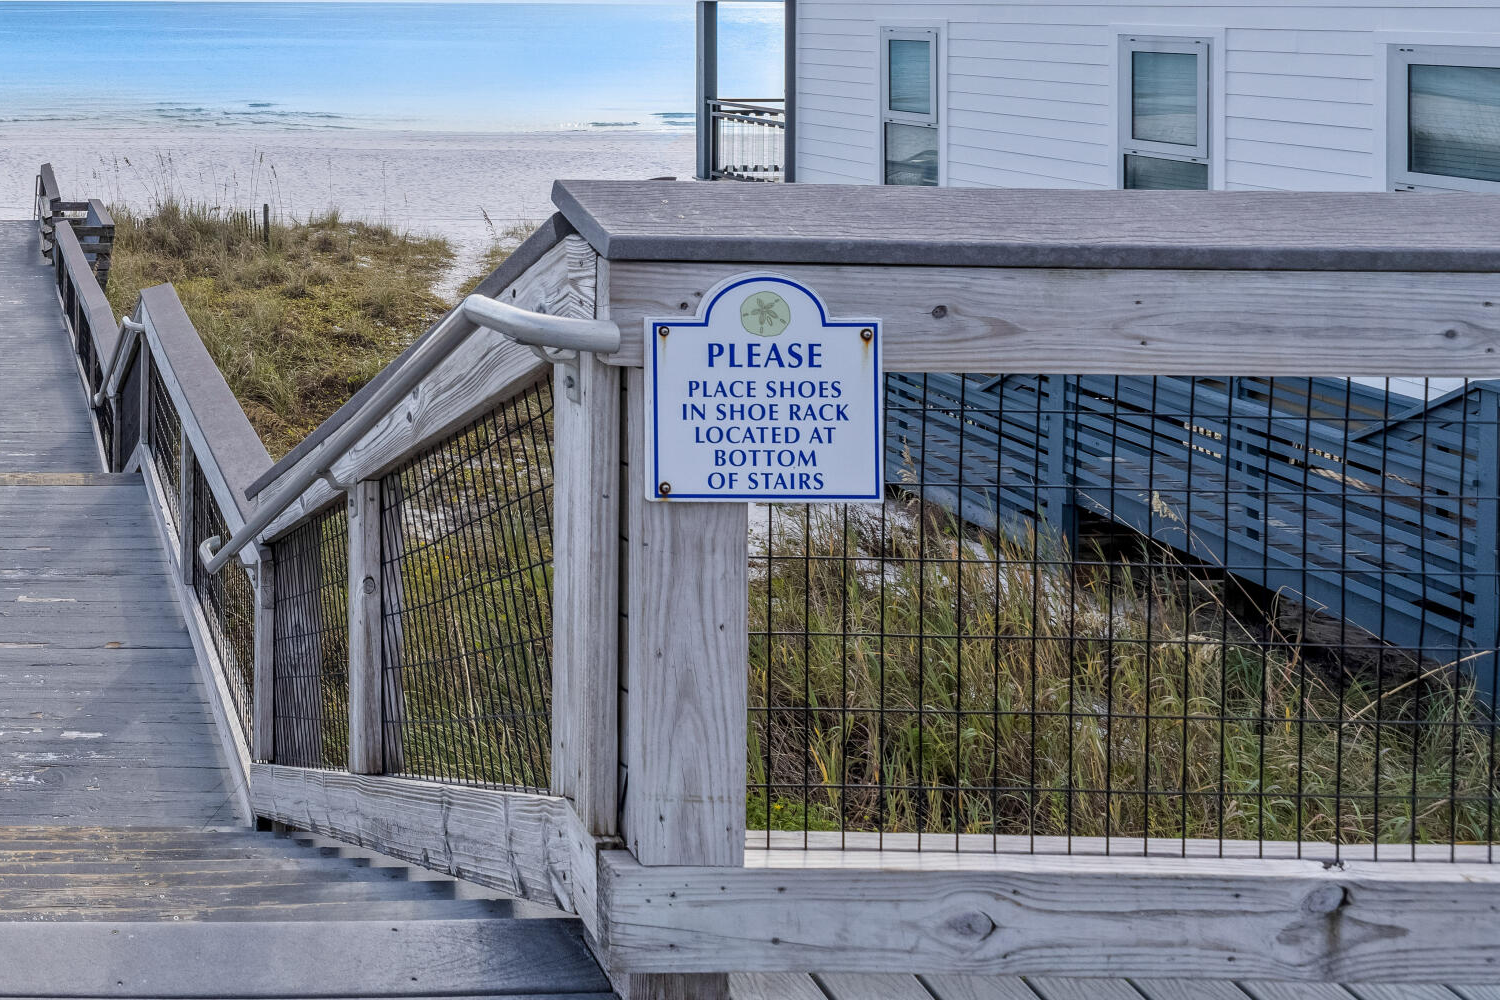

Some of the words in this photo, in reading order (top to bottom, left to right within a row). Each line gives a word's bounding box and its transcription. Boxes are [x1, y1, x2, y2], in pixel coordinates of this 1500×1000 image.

[707, 342, 822, 369] PLEASE
[688, 380, 757, 398] PLACE
[765, 380, 842, 399] SHOES
[682, 403, 706, 421] IN
[715, 403, 779, 421] SHOE
[789, 403, 849, 422] RACK
[695, 426, 801, 444] LOCATED
[808, 426, 837, 444] AT
[714, 449, 817, 467] BOTTOM
[707, 471, 739, 490] OF
[747, 472, 824, 491] STAIRS
